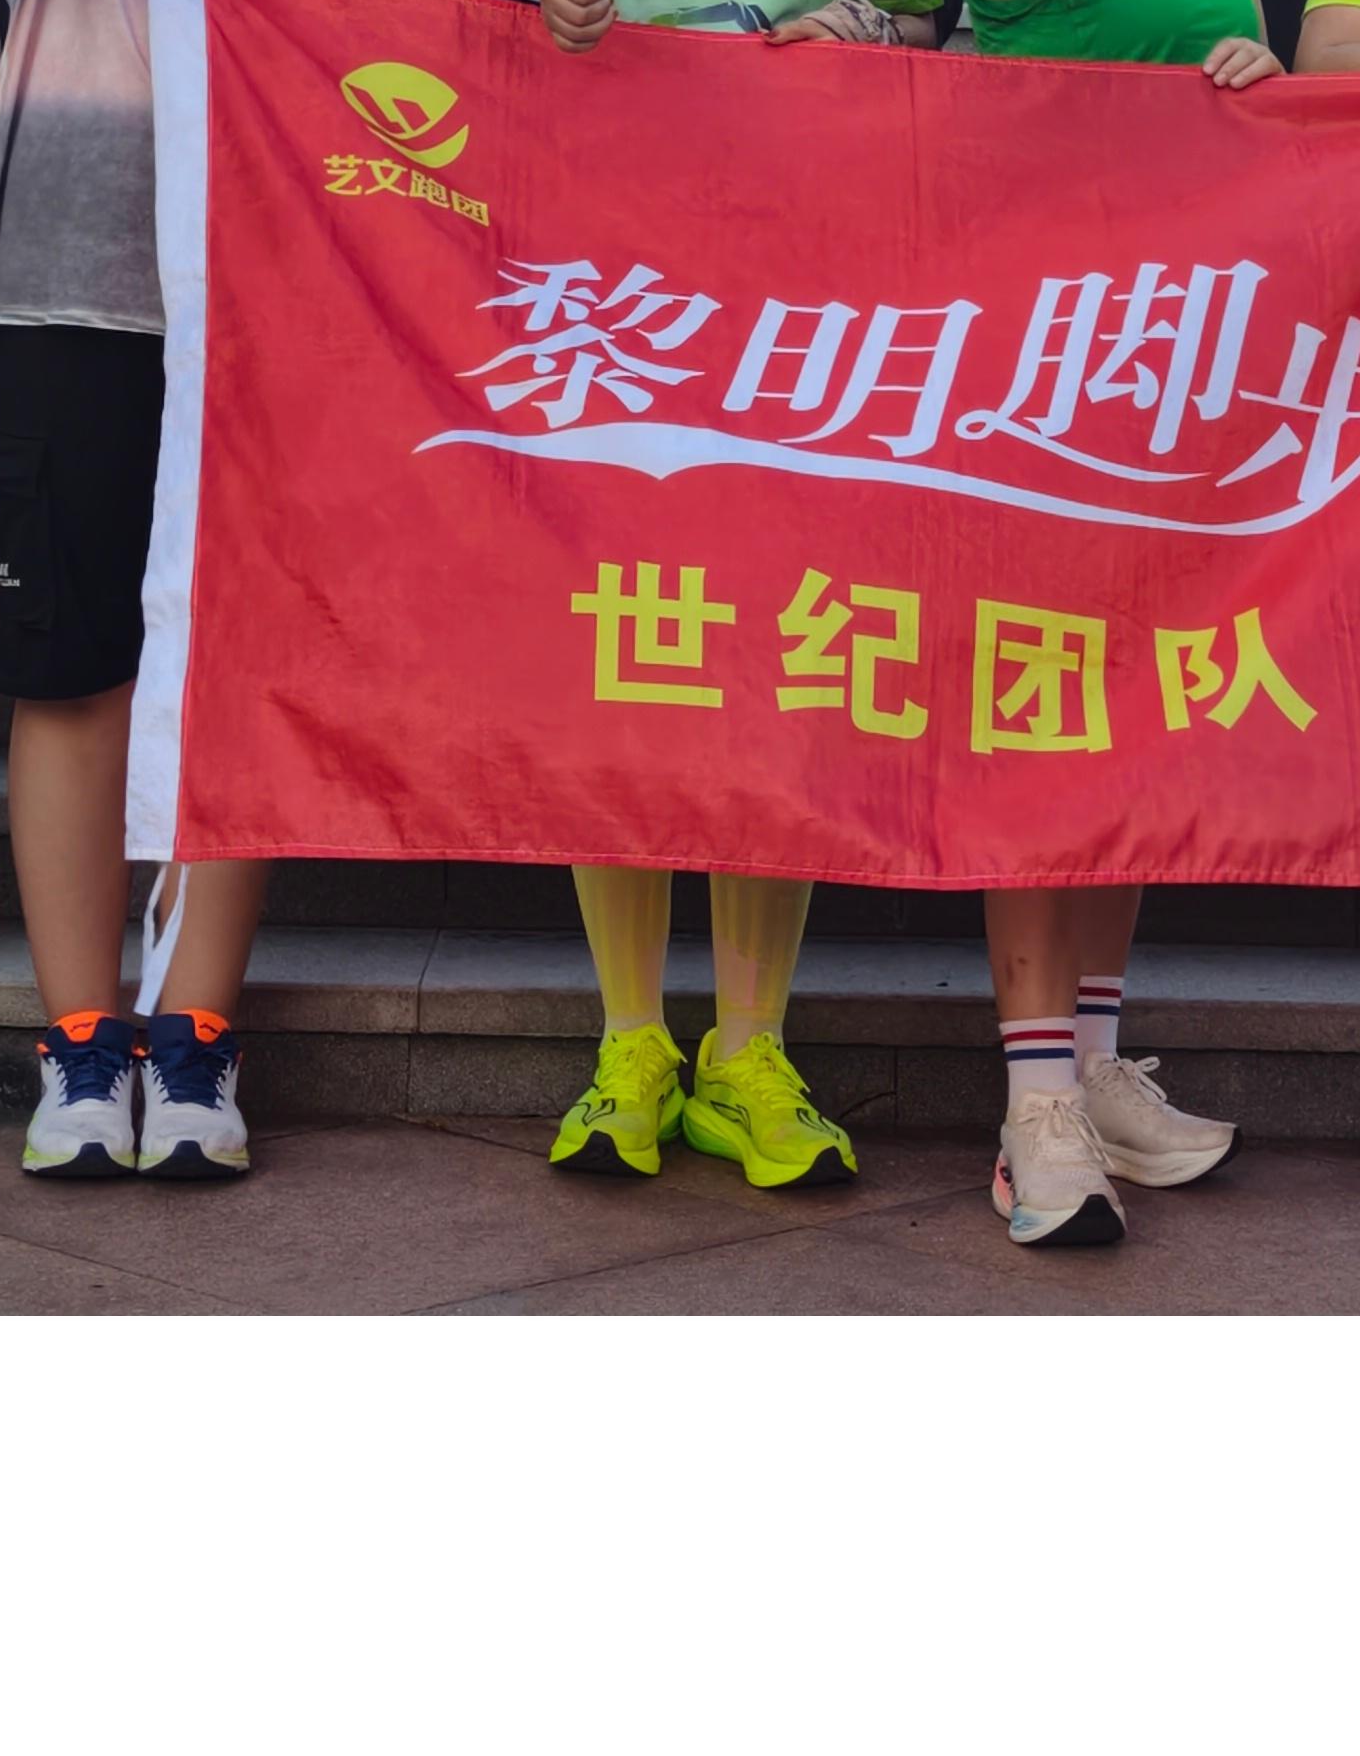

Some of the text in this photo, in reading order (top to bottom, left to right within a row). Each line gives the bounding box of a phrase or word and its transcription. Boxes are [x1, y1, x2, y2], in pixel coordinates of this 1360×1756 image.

[323, 153, 490, 227] 艺文跑团
[571, 561, 1318, 754] 世纪团队
